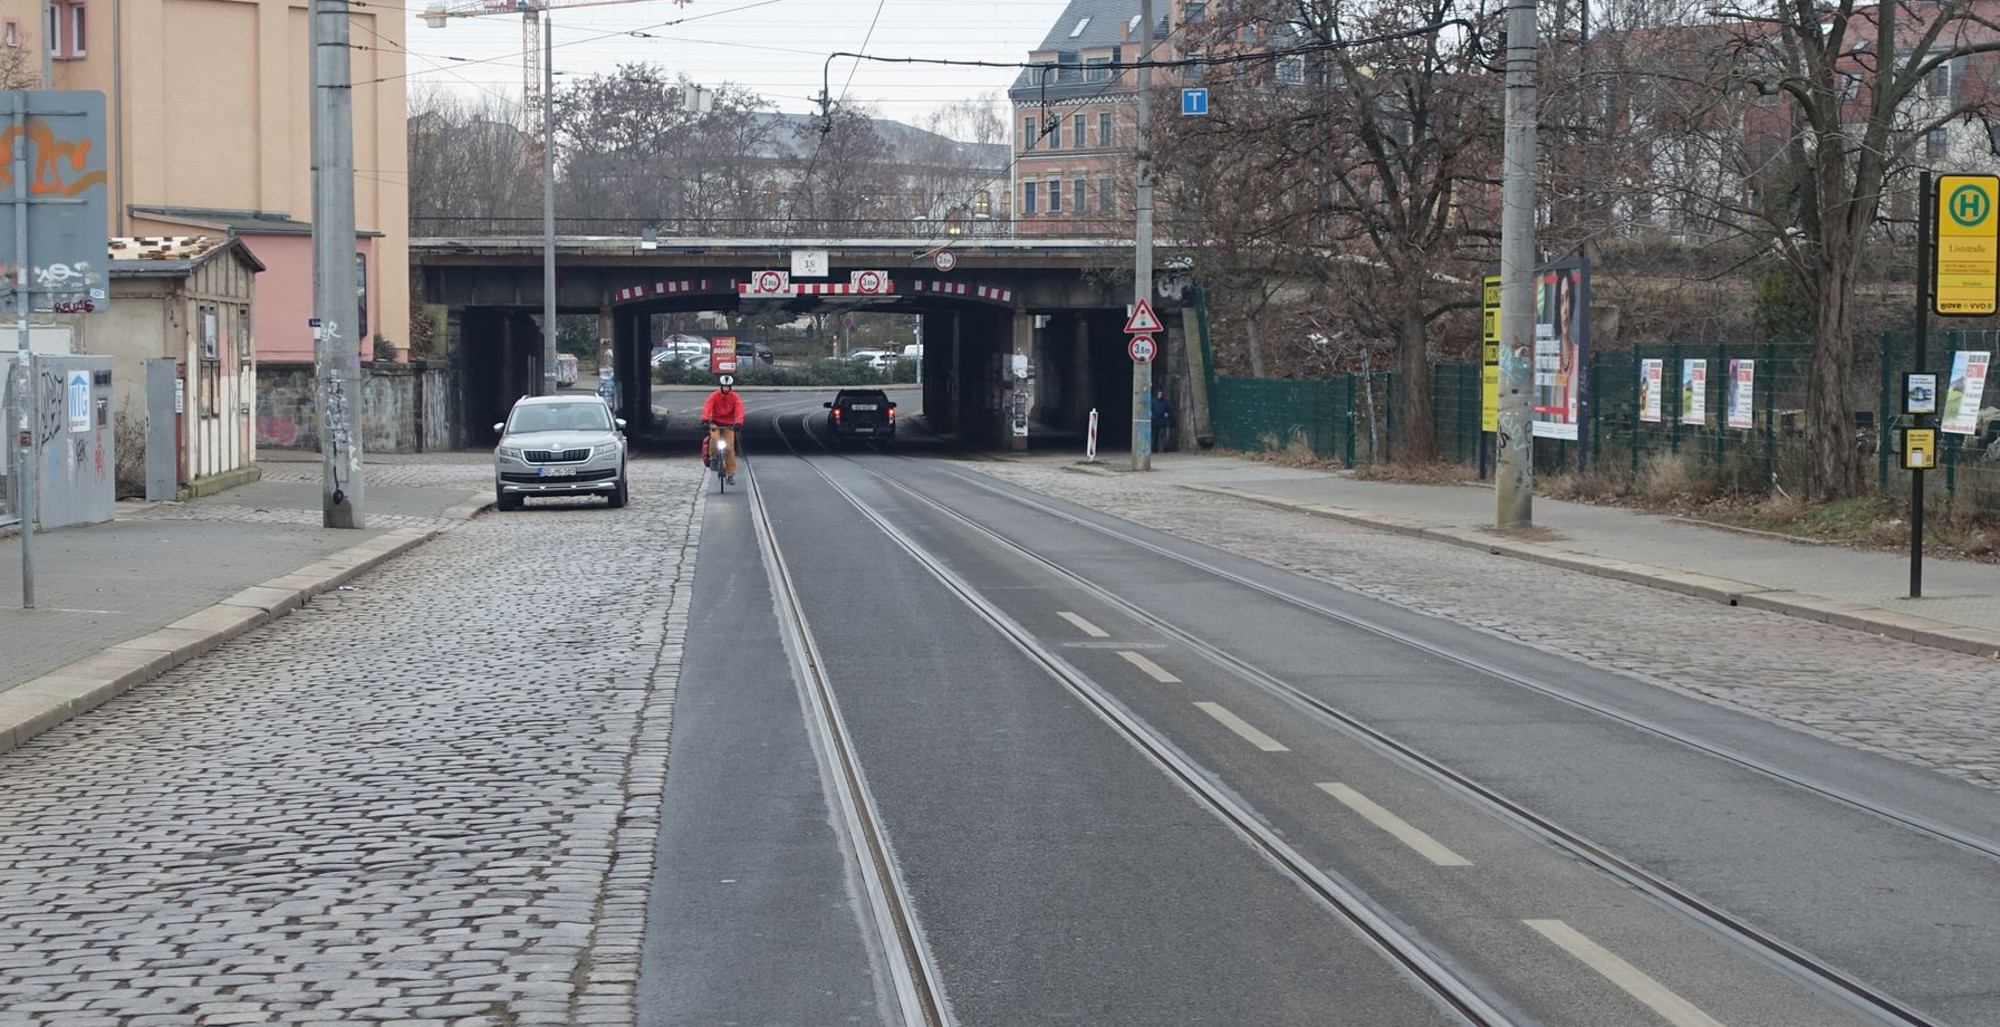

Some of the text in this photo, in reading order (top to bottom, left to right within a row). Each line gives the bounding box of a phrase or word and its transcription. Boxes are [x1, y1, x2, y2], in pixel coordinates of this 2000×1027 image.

[1188, 92, 1202, 110] T
[1960, 194, 1979, 217] H
[1949, 244, 1986, 253] Liststraße
